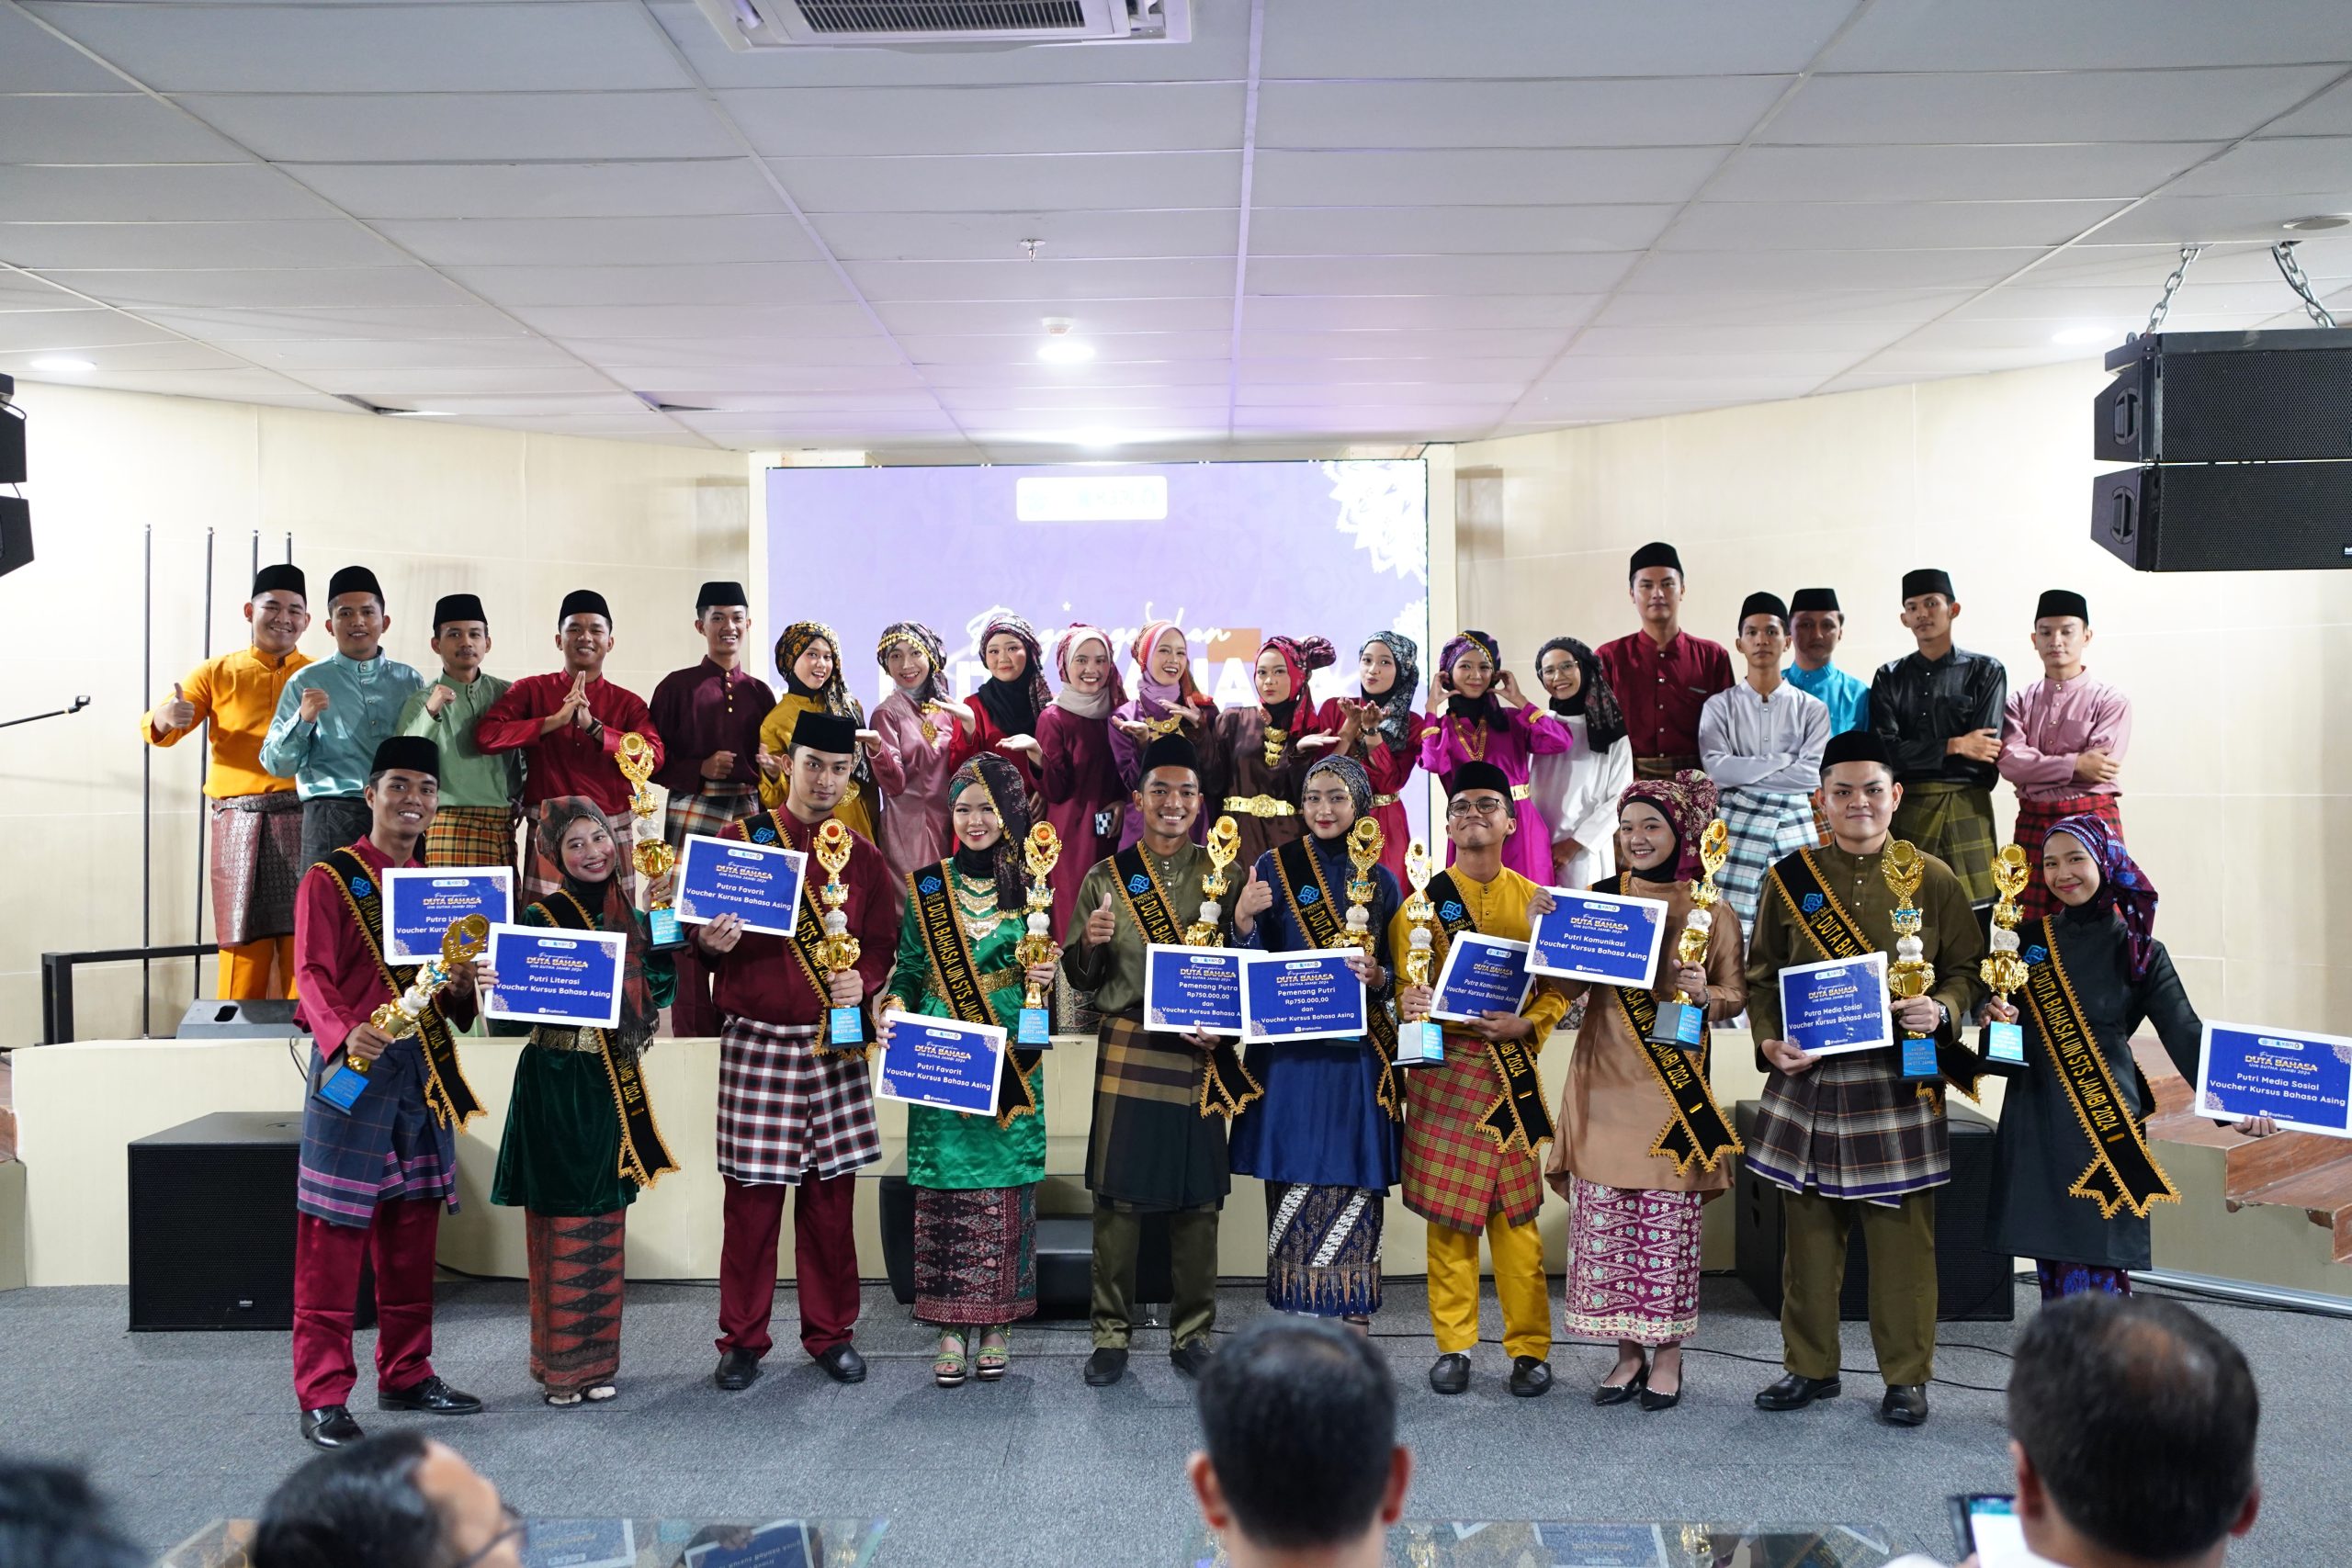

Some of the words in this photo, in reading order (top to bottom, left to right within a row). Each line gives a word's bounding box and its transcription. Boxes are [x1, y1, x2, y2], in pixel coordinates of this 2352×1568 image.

[717, 865, 739, 874] DUTA
[740, 869, 773, 880] BAHASA
[686, 887, 716, 897] Voucher
[718, 893, 742, 902] Kursus
[744, 897, 770, 907] Bahasa
[772, 902, 791, 910] Asing
[717, 883, 736, 891] Putra
[739, 886, 764, 896] Favorit
[1137, 896, 1155, 905] PUTRA
[927, 902, 948, 930] DUTA
[1141, 900, 1166, 929] DUTA
[1309, 910, 1334, 939] DUTA
[1570, 918, 1592, 926] DUTA
[1594, 921, 1629, 931] BAHASA
[798, 920, 819, 945] STS
[1152, 924, 1176, 944] BAH
[1584, 936, 1626, 947] Komunikasi
[1816, 915, 1845, 946] DUTA
[1835, 938, 1860, 959] BAH
[933, 926, 959, 967] BAHASA
[1539, 940, 1568, 949] Voucher
[1571, 943, 1596, 953] Kursus
[1598, 948, 1625, 957] Bahasa
[1627, 952, 1647, 961] Asing
[552, 959, 589, 968] BAHASA
[945, 961, 966, 983] UIN
[1204, 970, 1236, 978] BAHASA
[529, 975, 548, 983] Putri
[1179, 982, 1216, 991] Pemenang
[1479, 980, 1508, 991] Komunikasi
[2032, 971, 2055, 1002] DUTA
[530, 986, 557, 994] Kursus
[559, 987, 587, 996] Bahasa
[590, 990, 611, 998] Asing
[952, 980, 974, 1000] STS
[1446, 986, 1466, 994] Voucher
[1468, 987, 1485, 997] Kursus
[1486, 992, 1505, 1000] Bahasa
[1506, 996, 1519, 1004] Asing
[1808, 990, 1827, 999] DUTA
[1828, 986, 1858, 996] BAHASA
[960, 998, 985, 1024] JAMB
[1285, 997, 1329, 1005] Rp750.000,00
[1843, 1003, 1862, 1011] Sosial
[1633, 1004, 1656, 1028] UIN
[1789, 1021, 1814, 1030] Voucher
[2043, 997, 2075, 1042] BAHASA
[428, 1026, 447, 1051] 2024
[2060, 1036, 2085, 1058] UIN
[915, 1045, 937, 1055] DUTA
[938, 1049, 971, 1060] BAHASA
[936, 1066, 963, 1075] Favorit
[1506, 1055, 1528, 1077] 2024
[1651, 1043, 1682, 1070] JAMBI
[1668, 1064, 1692, 1089] 2024
[2068, 1055, 2094, 1077] STS
[2245, 1055, 2272, 1066] DUTA
[2275, 1059, 2318, 1072] BAHASA
[887, 1067, 915, 1077] Voucher
[917, 1073, 941, 1082] Kursus
[943, 1077, 969, 1086] Bahasa
[972, 1081, 991, 1090] Asing
[2237, 1073, 2259, 1082] Putri
[2262, 1077, 2289, 1087] Media
[2291, 1080, 2319, 1091] Sosial
[623, 1081, 641, 1104] 2024
[2077, 1077, 2108, 1109] JAMBI
[2210, 1079, 2247, 1091] Voucher
[2250, 1085, 2280, 1097] Kursus
[2283, 1090, 2317, 1101] Bahasa
[2320, 1096, 2346, 1107] Asing
[2091, 1105, 2120, 1133] 2024
